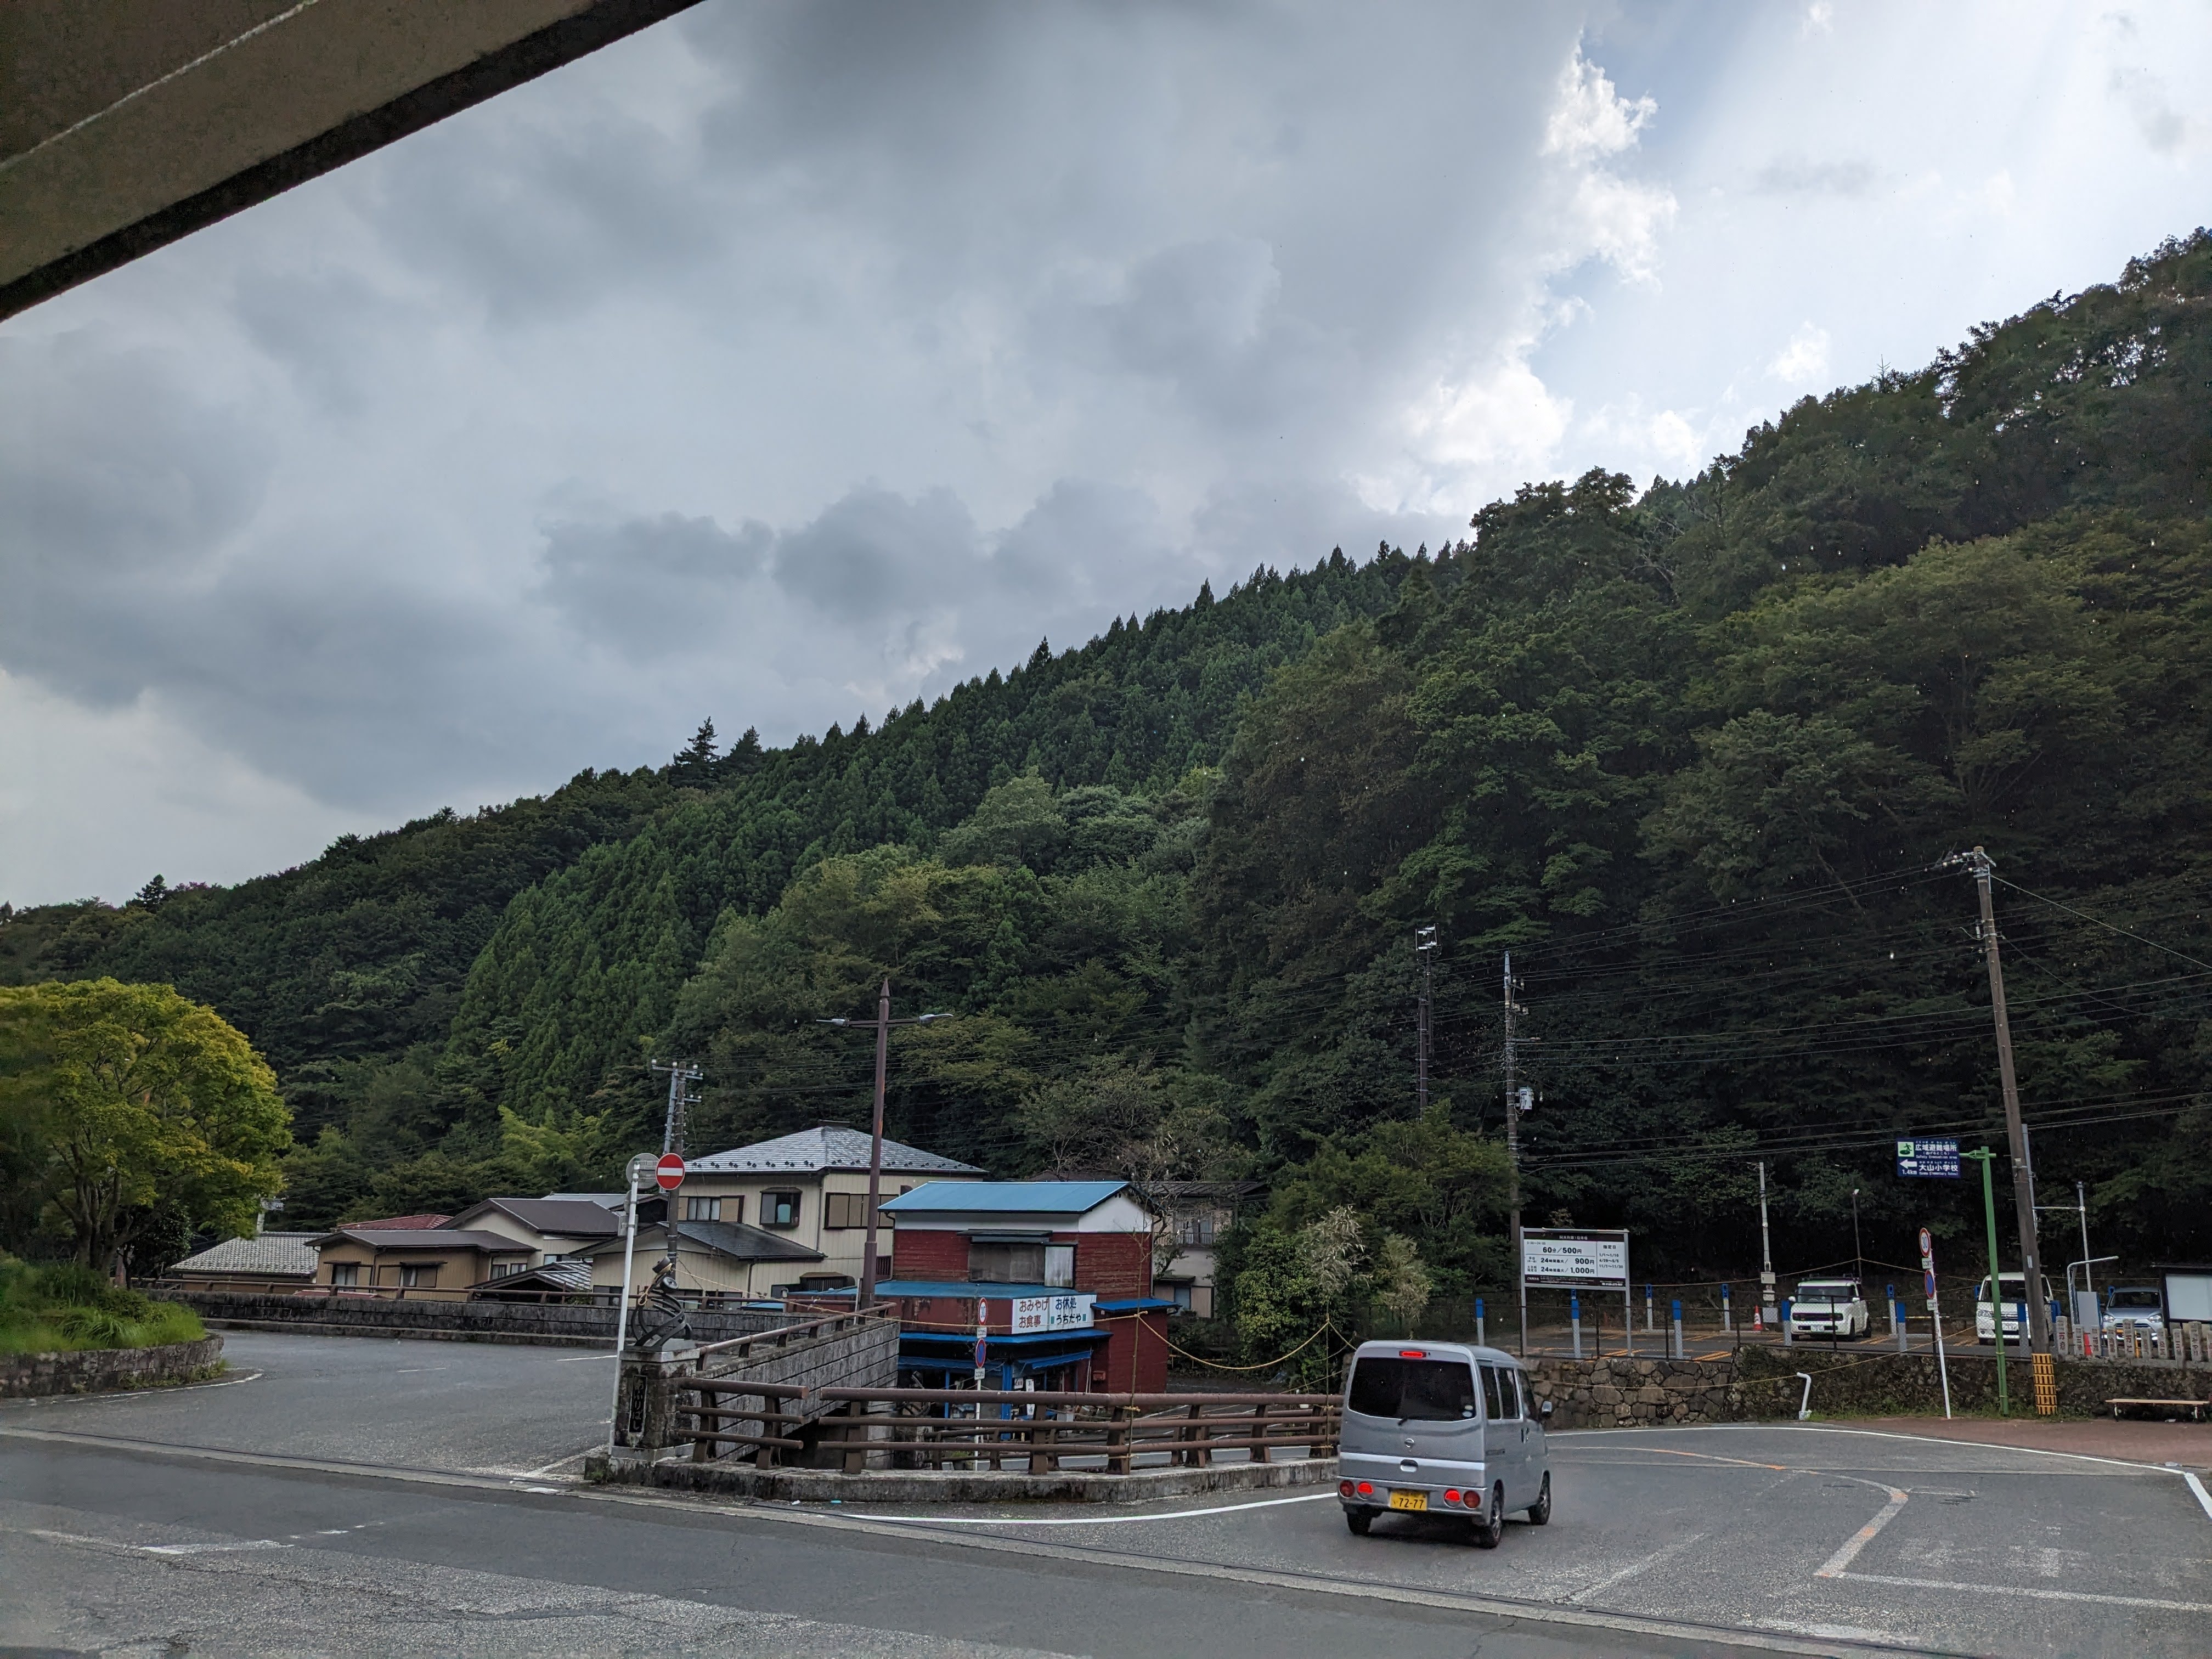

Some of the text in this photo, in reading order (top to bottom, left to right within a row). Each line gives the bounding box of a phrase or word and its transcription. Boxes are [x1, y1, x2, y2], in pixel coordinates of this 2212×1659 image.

[1922, 1236, 1928, 1249] 30
[1019, 1297, 1049, 1312] おみやげ
[1056, 1297, 1077, 1310] お休処
[1019, 1314, 1041, 1328] お食事
[1056, 1313, 1081, 1325] うちだや
[1400, 1498, 1424, 1509] 72-77
